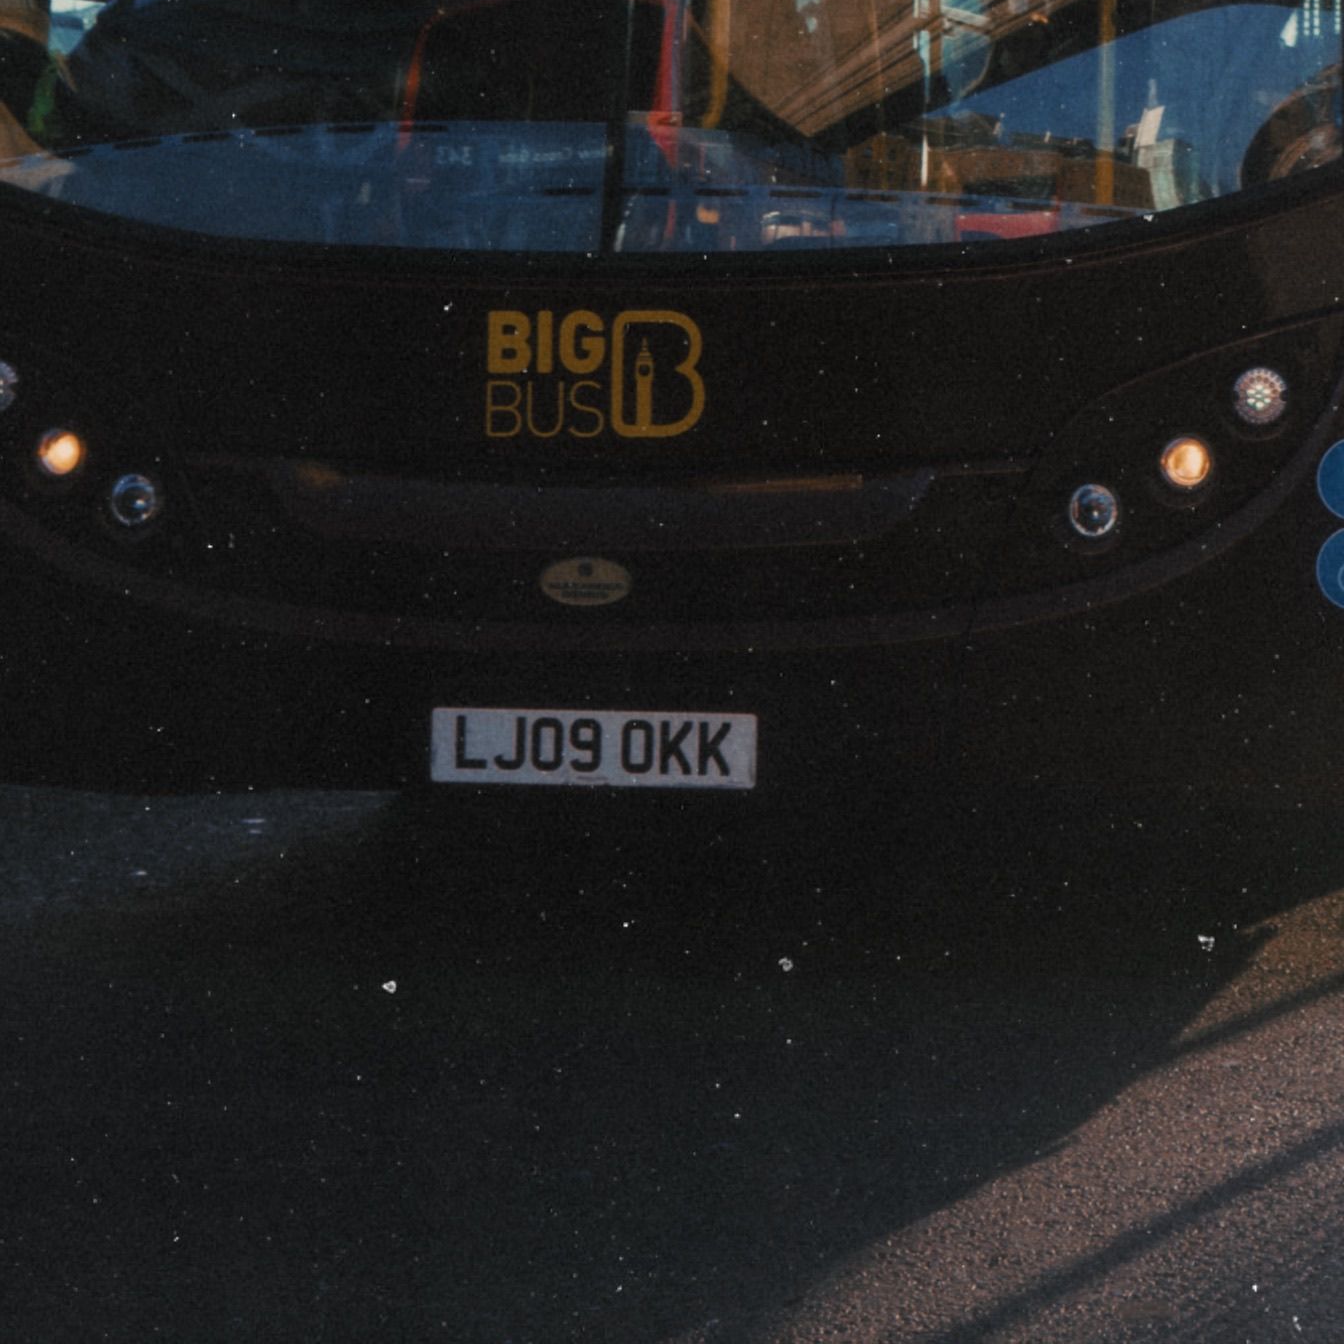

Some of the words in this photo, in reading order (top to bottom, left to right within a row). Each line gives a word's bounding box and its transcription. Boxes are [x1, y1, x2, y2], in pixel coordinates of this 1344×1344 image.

[487, 310, 606, 374] BIG
[486, 379, 604, 438] BUS
[454, 714, 602, 773] LJ09
[621, 719, 732, 777] OKK
